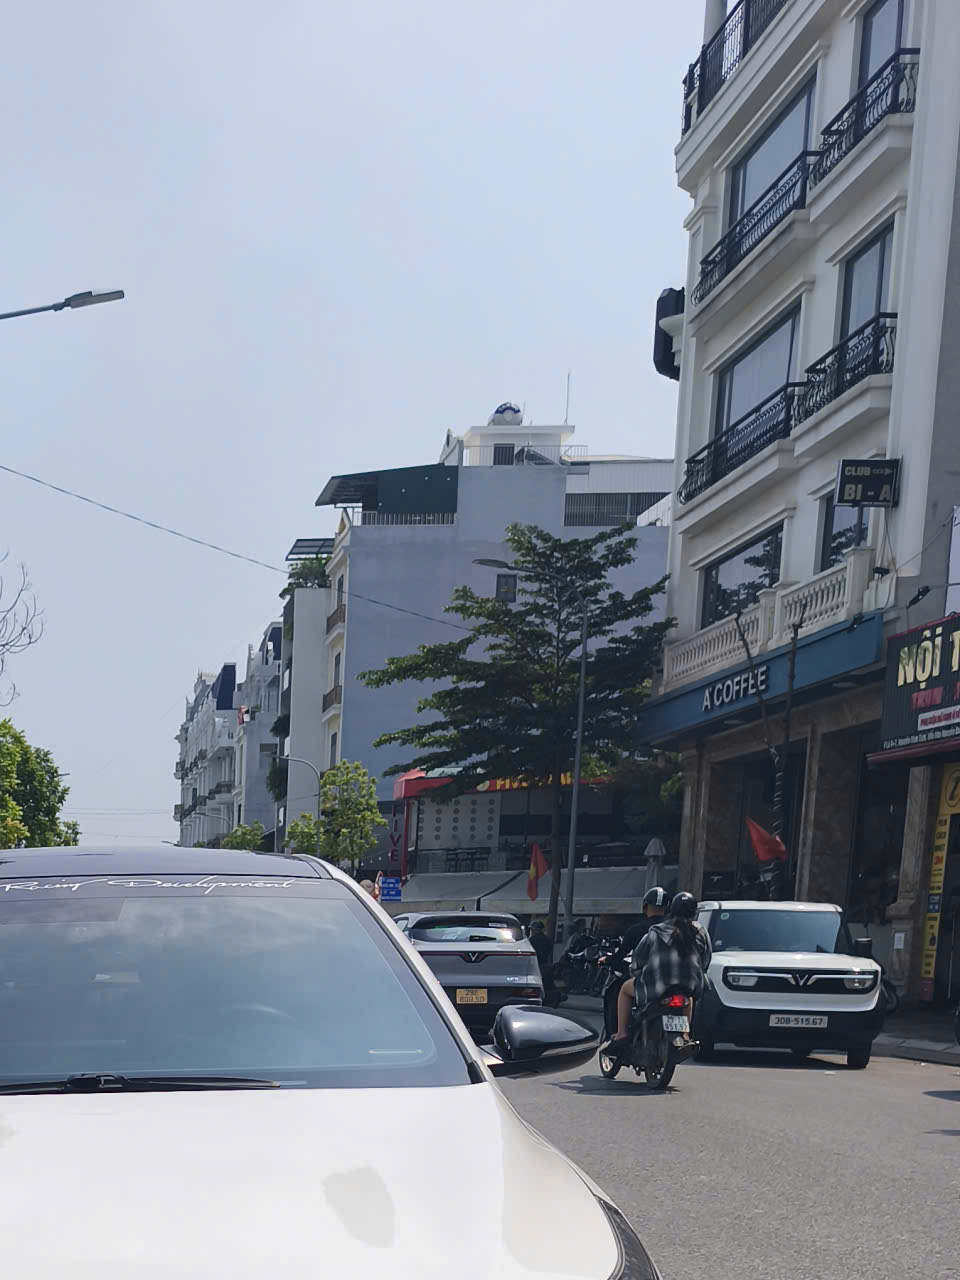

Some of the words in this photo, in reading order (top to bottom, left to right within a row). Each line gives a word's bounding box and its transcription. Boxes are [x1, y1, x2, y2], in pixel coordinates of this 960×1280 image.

[844, 466, 871, 476] CLUB
[897, 626, 943, 689] NỘI
[107, 875, 308, 894] Development
